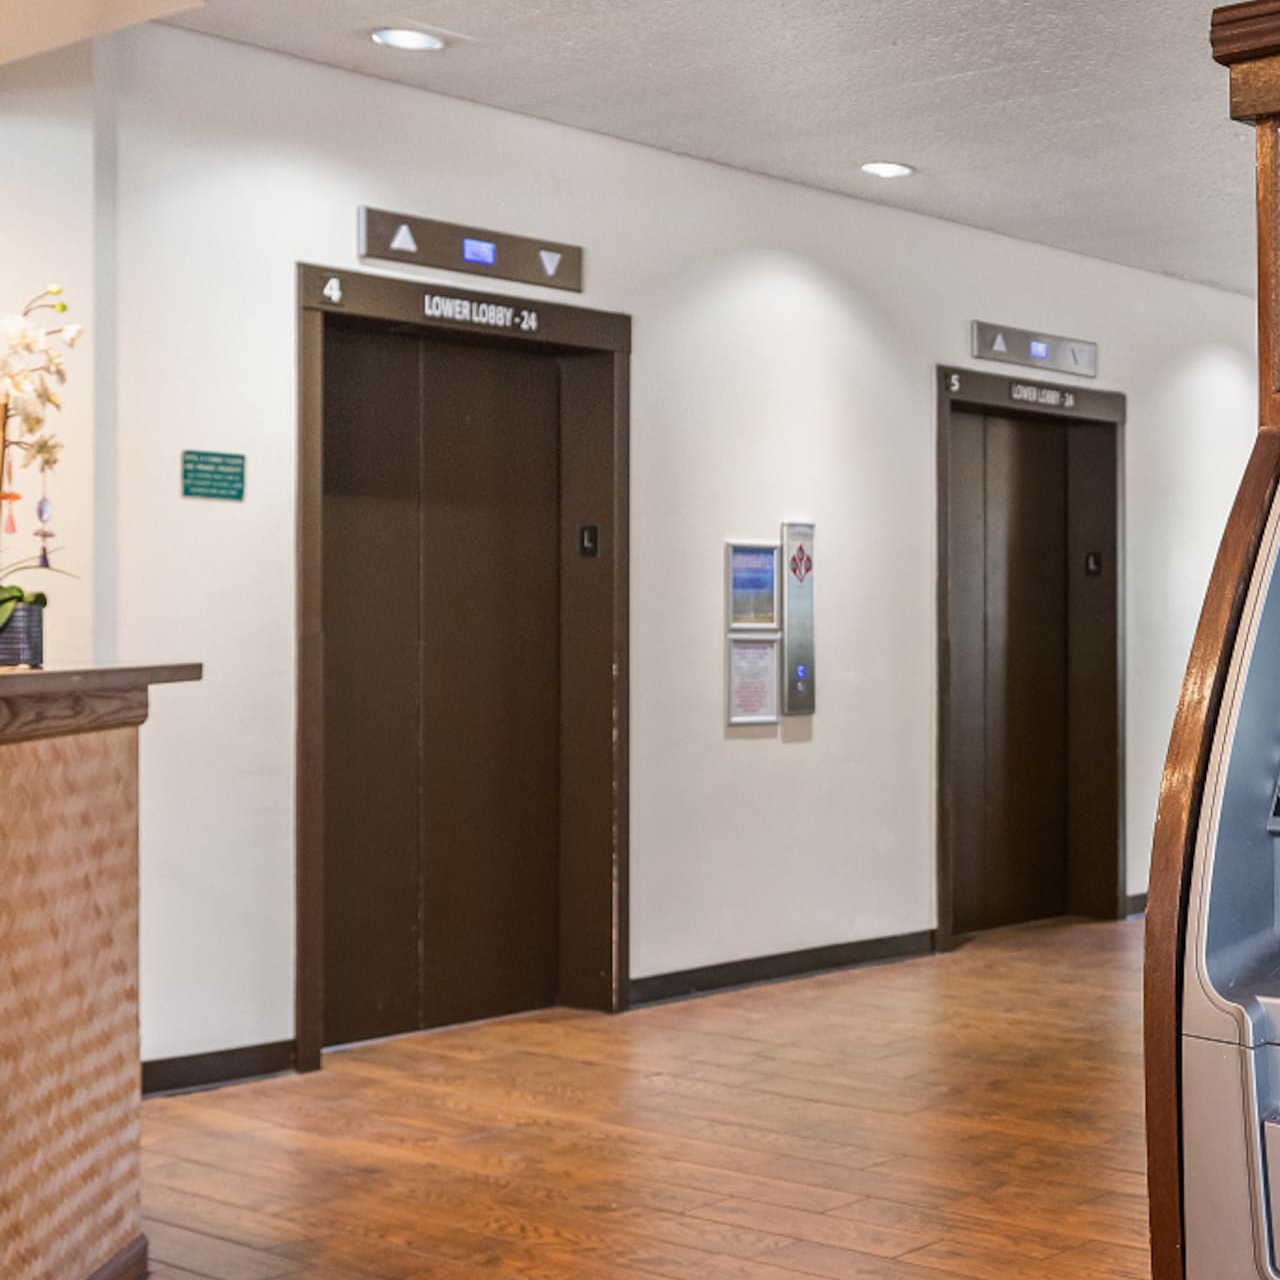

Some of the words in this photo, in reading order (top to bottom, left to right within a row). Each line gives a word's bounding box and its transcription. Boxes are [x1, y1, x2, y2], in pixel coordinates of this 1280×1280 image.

[323, 277, 342, 303] 4
[424, 293, 470, 321] LOWER
[471, 301, 513, 327] LOBBY
[520, 309, 538, 331] 24
[584, 529, 593, 548] L
